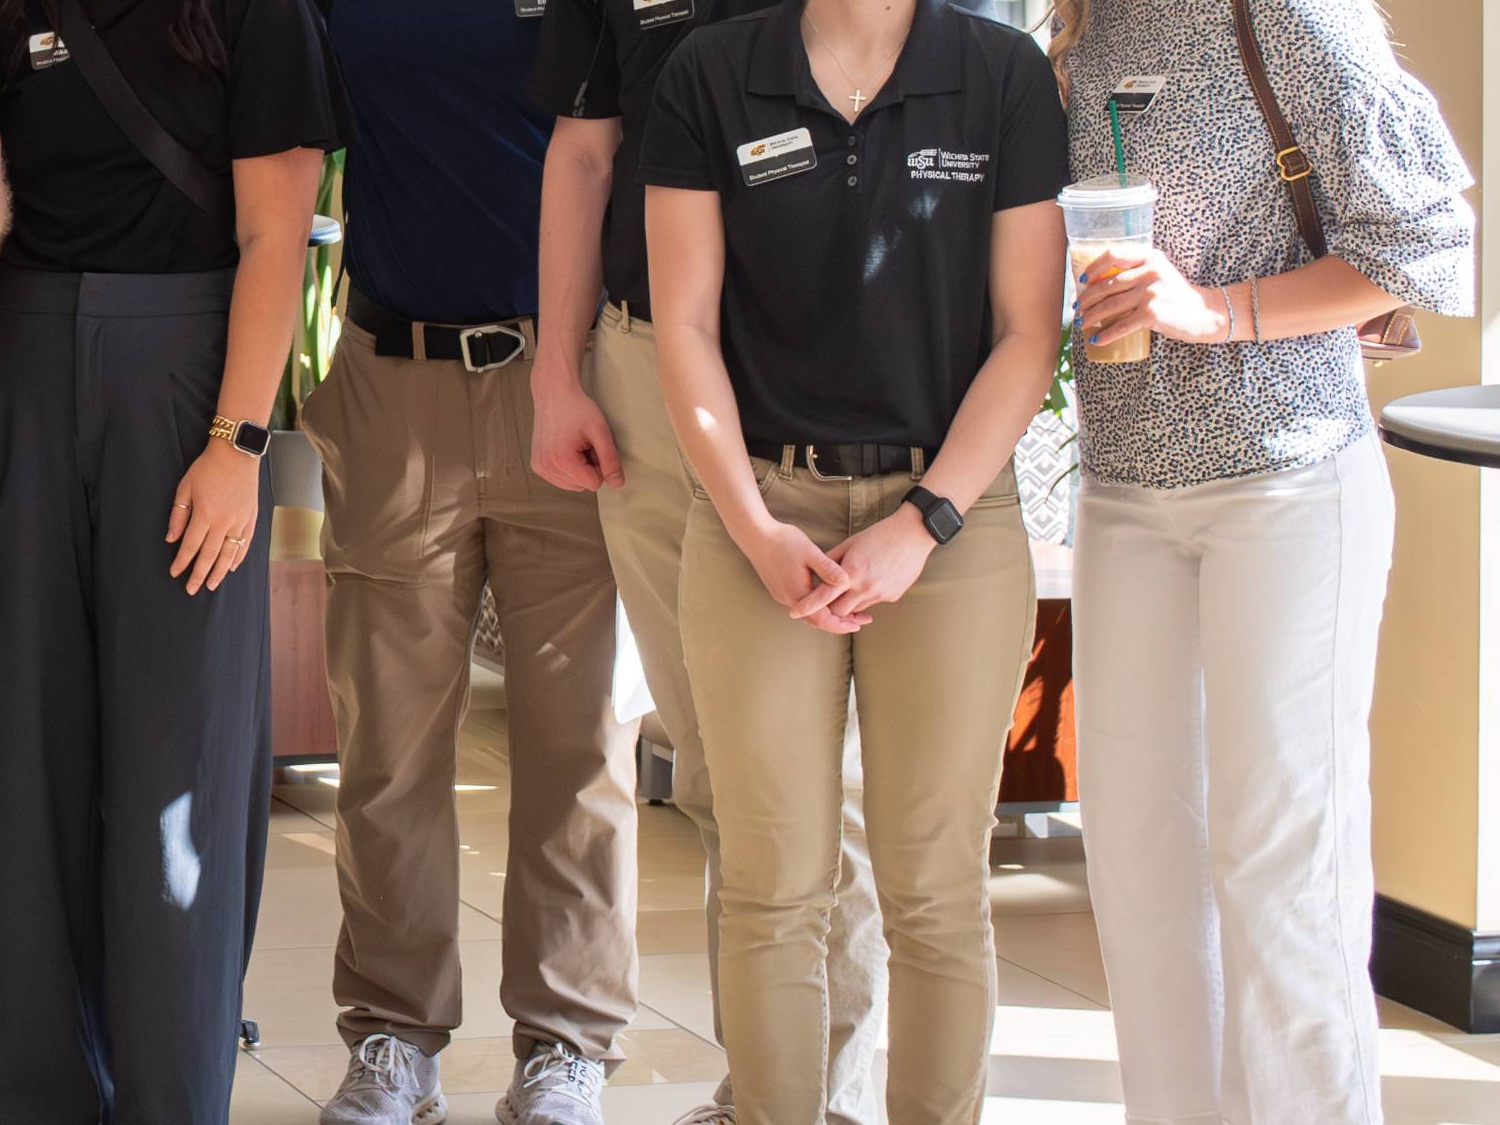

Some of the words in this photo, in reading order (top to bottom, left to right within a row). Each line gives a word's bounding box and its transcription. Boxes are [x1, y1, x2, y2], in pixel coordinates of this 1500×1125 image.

[941, 151, 969, 161] WICHITA
[970, 153, 989, 162] STATE
[941, 160, 980, 169] UNIVERSITY
[911, 170, 951, 180] PHYSICAL
[951, 172, 985, 182] THERAPY
